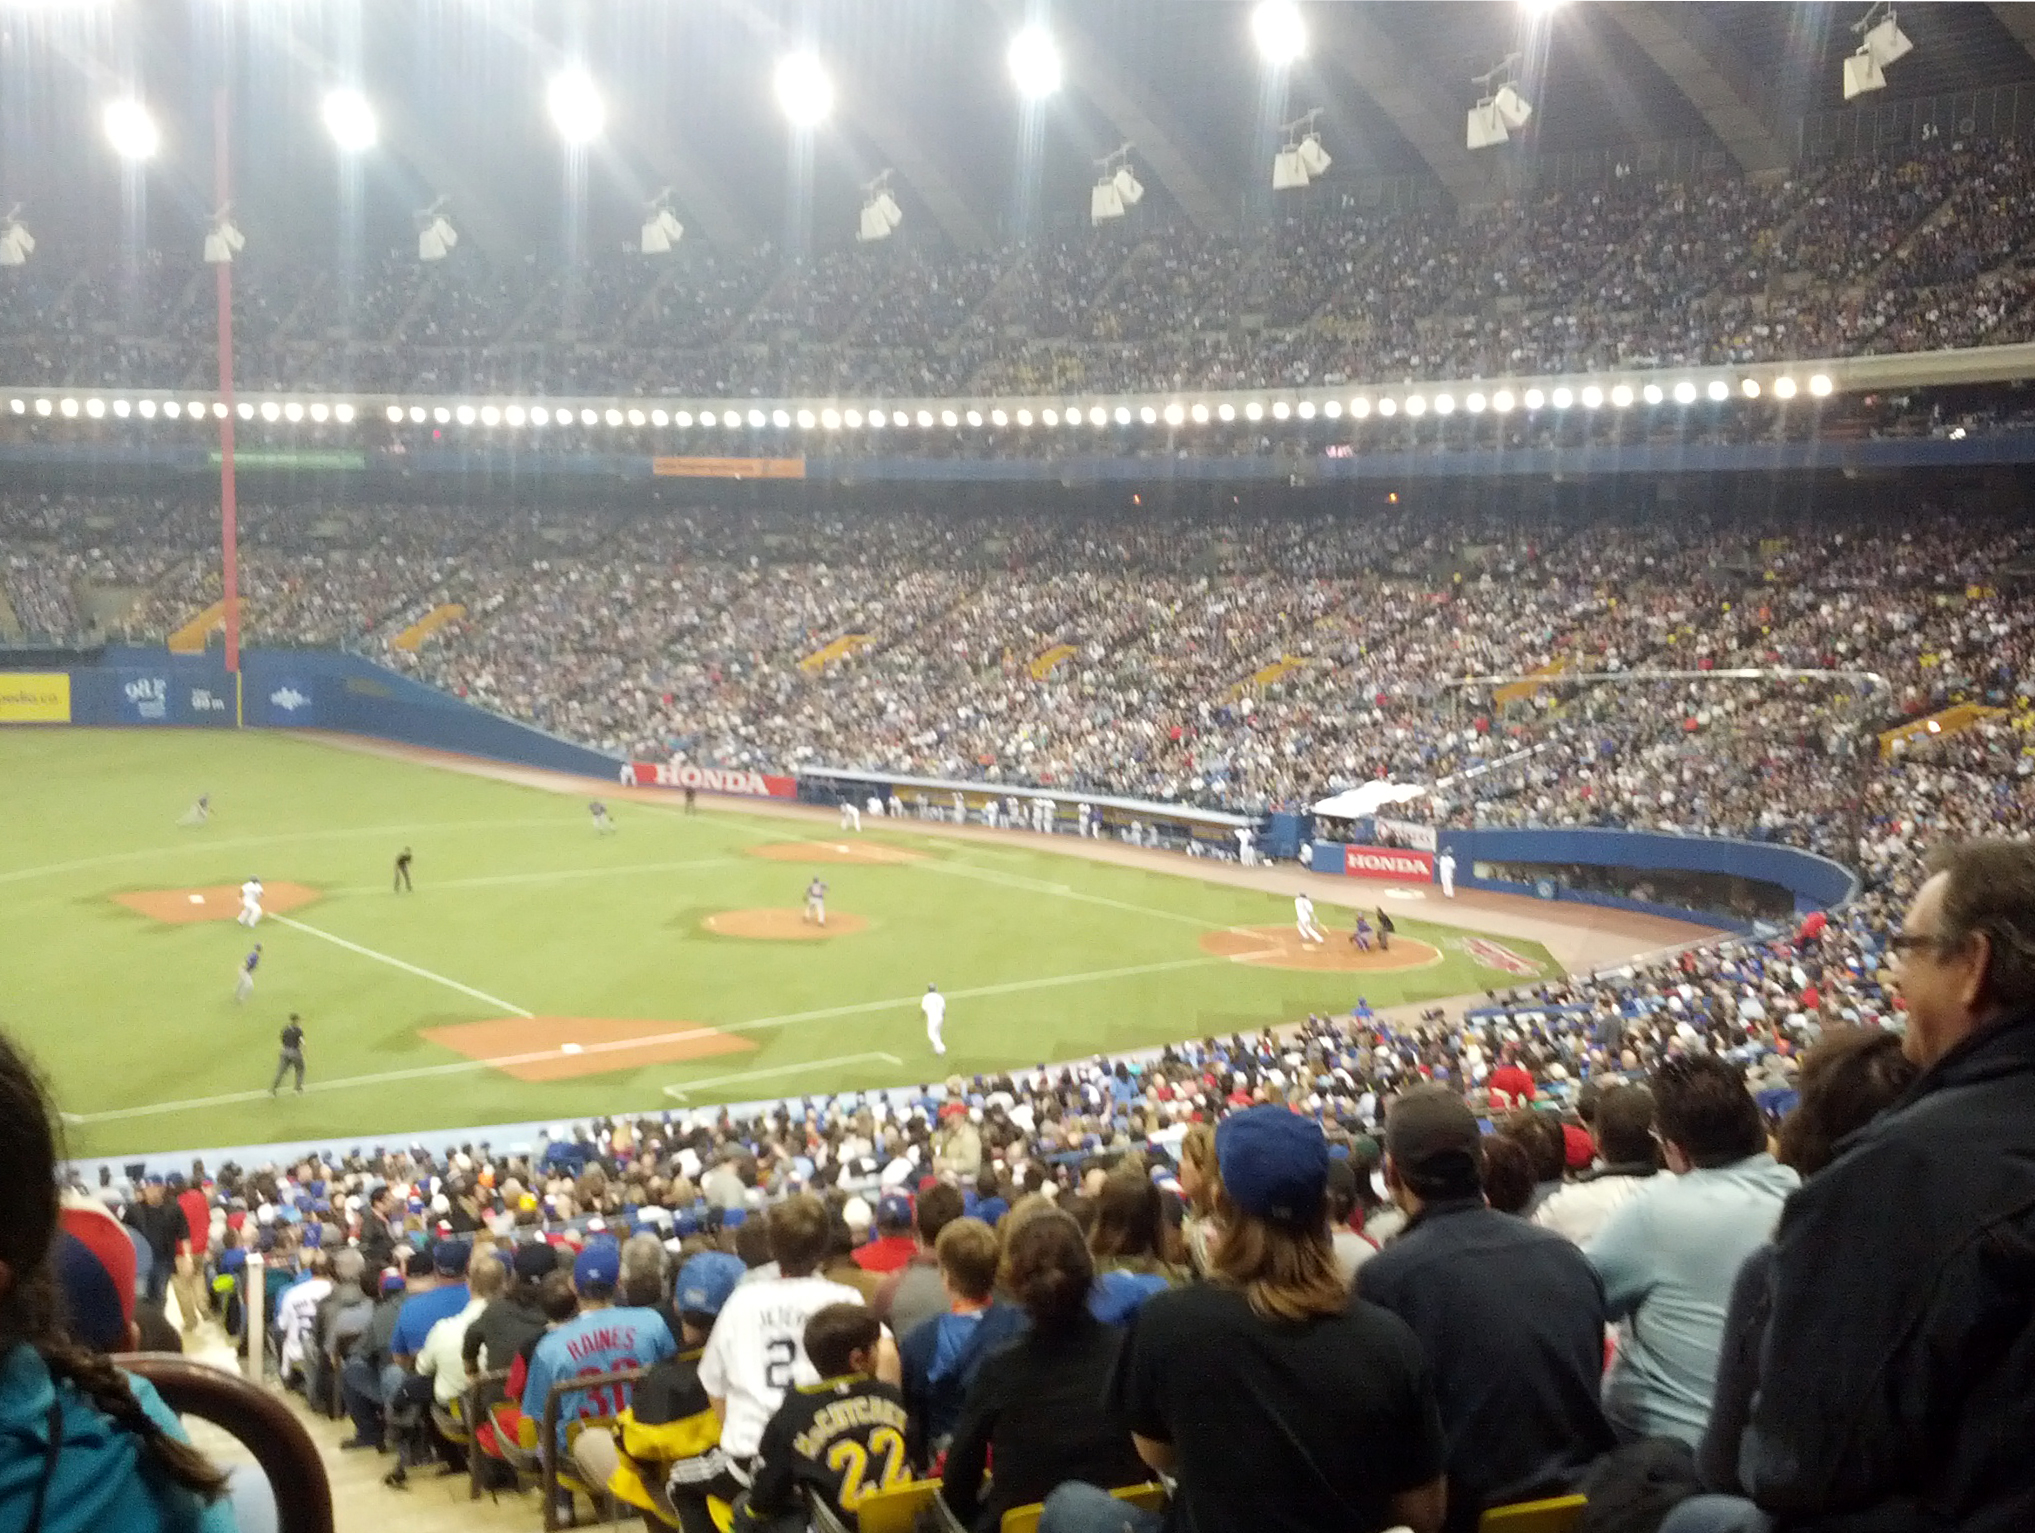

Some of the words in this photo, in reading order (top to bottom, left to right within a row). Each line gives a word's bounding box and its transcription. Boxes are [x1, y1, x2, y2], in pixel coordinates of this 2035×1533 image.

[656, 764, 770, 796] HONDA
[1347, 853, 1430, 875] HONDA
[566, 1326, 636, 1362] RAINES
[826, 1426, 912, 1511] 22
